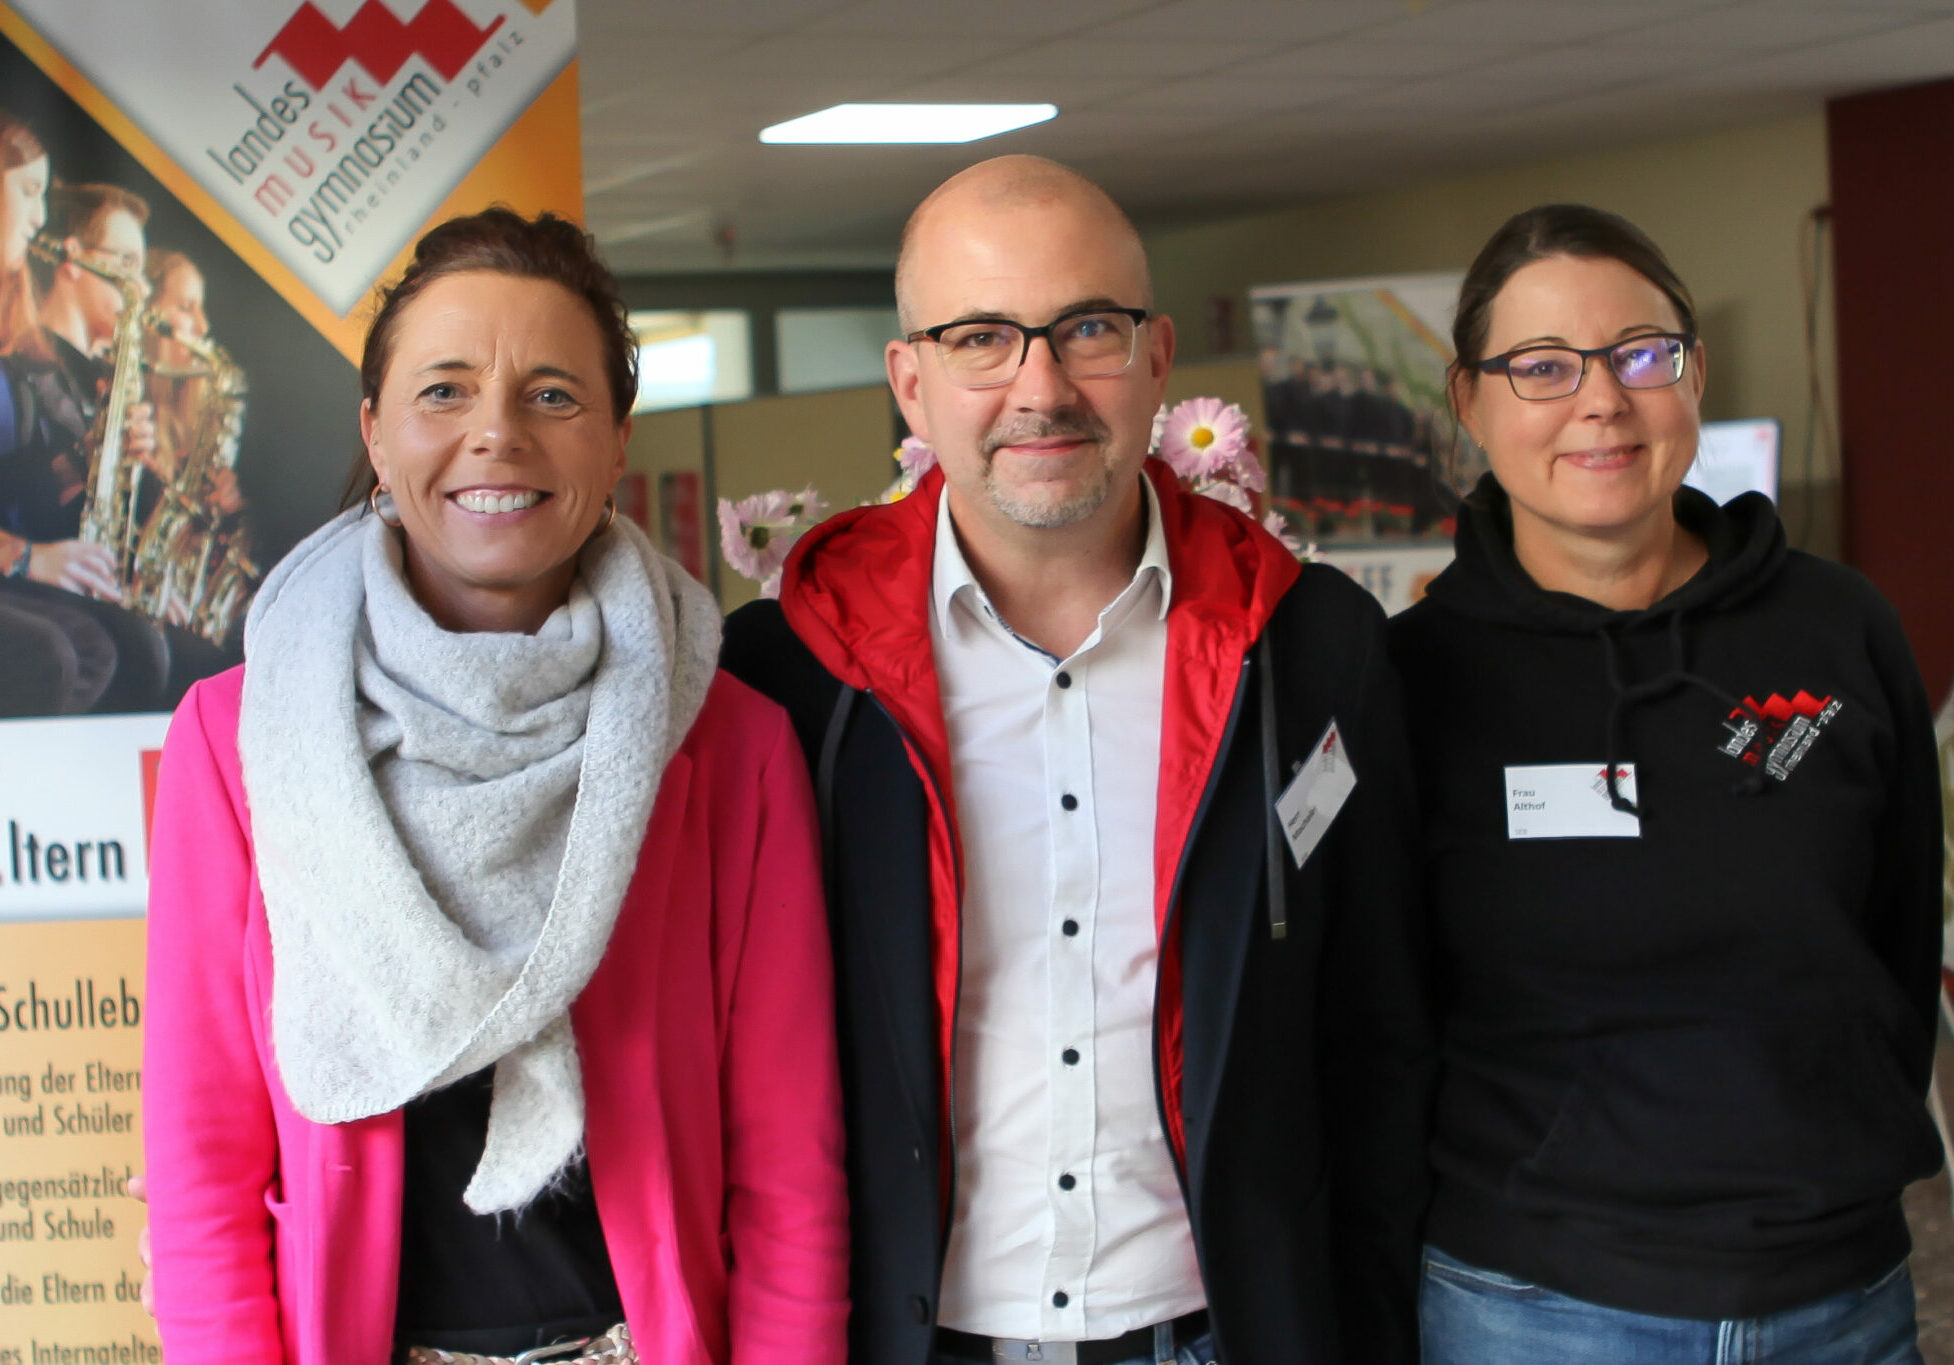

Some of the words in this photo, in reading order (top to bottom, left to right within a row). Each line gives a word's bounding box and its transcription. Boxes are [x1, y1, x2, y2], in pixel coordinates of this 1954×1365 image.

[206, 79, 312, 186] landes
[288, 71, 443, 264] gymnasium
[1717, 720, 1758, 758] landes
[1512, 789, 1536, 798] Frau
[1513, 801, 1546, 811] Althof
[0, 818, 126, 884] ltern
[0, 1073, 31, 1103] ng
[41, 1061, 76, 1094] der
[3, 1103, 44, 1137] und
[53, 1101, 134, 1136] Schüler
[0, 1165, 132, 1209] egensätzlic
[43, 1207, 115, 1241] Schule
[1, 1271, 33, 1306] die
[42, 1271, 105, 1304] Eltern
[31, 1334, 164, 1365] Internatelte
